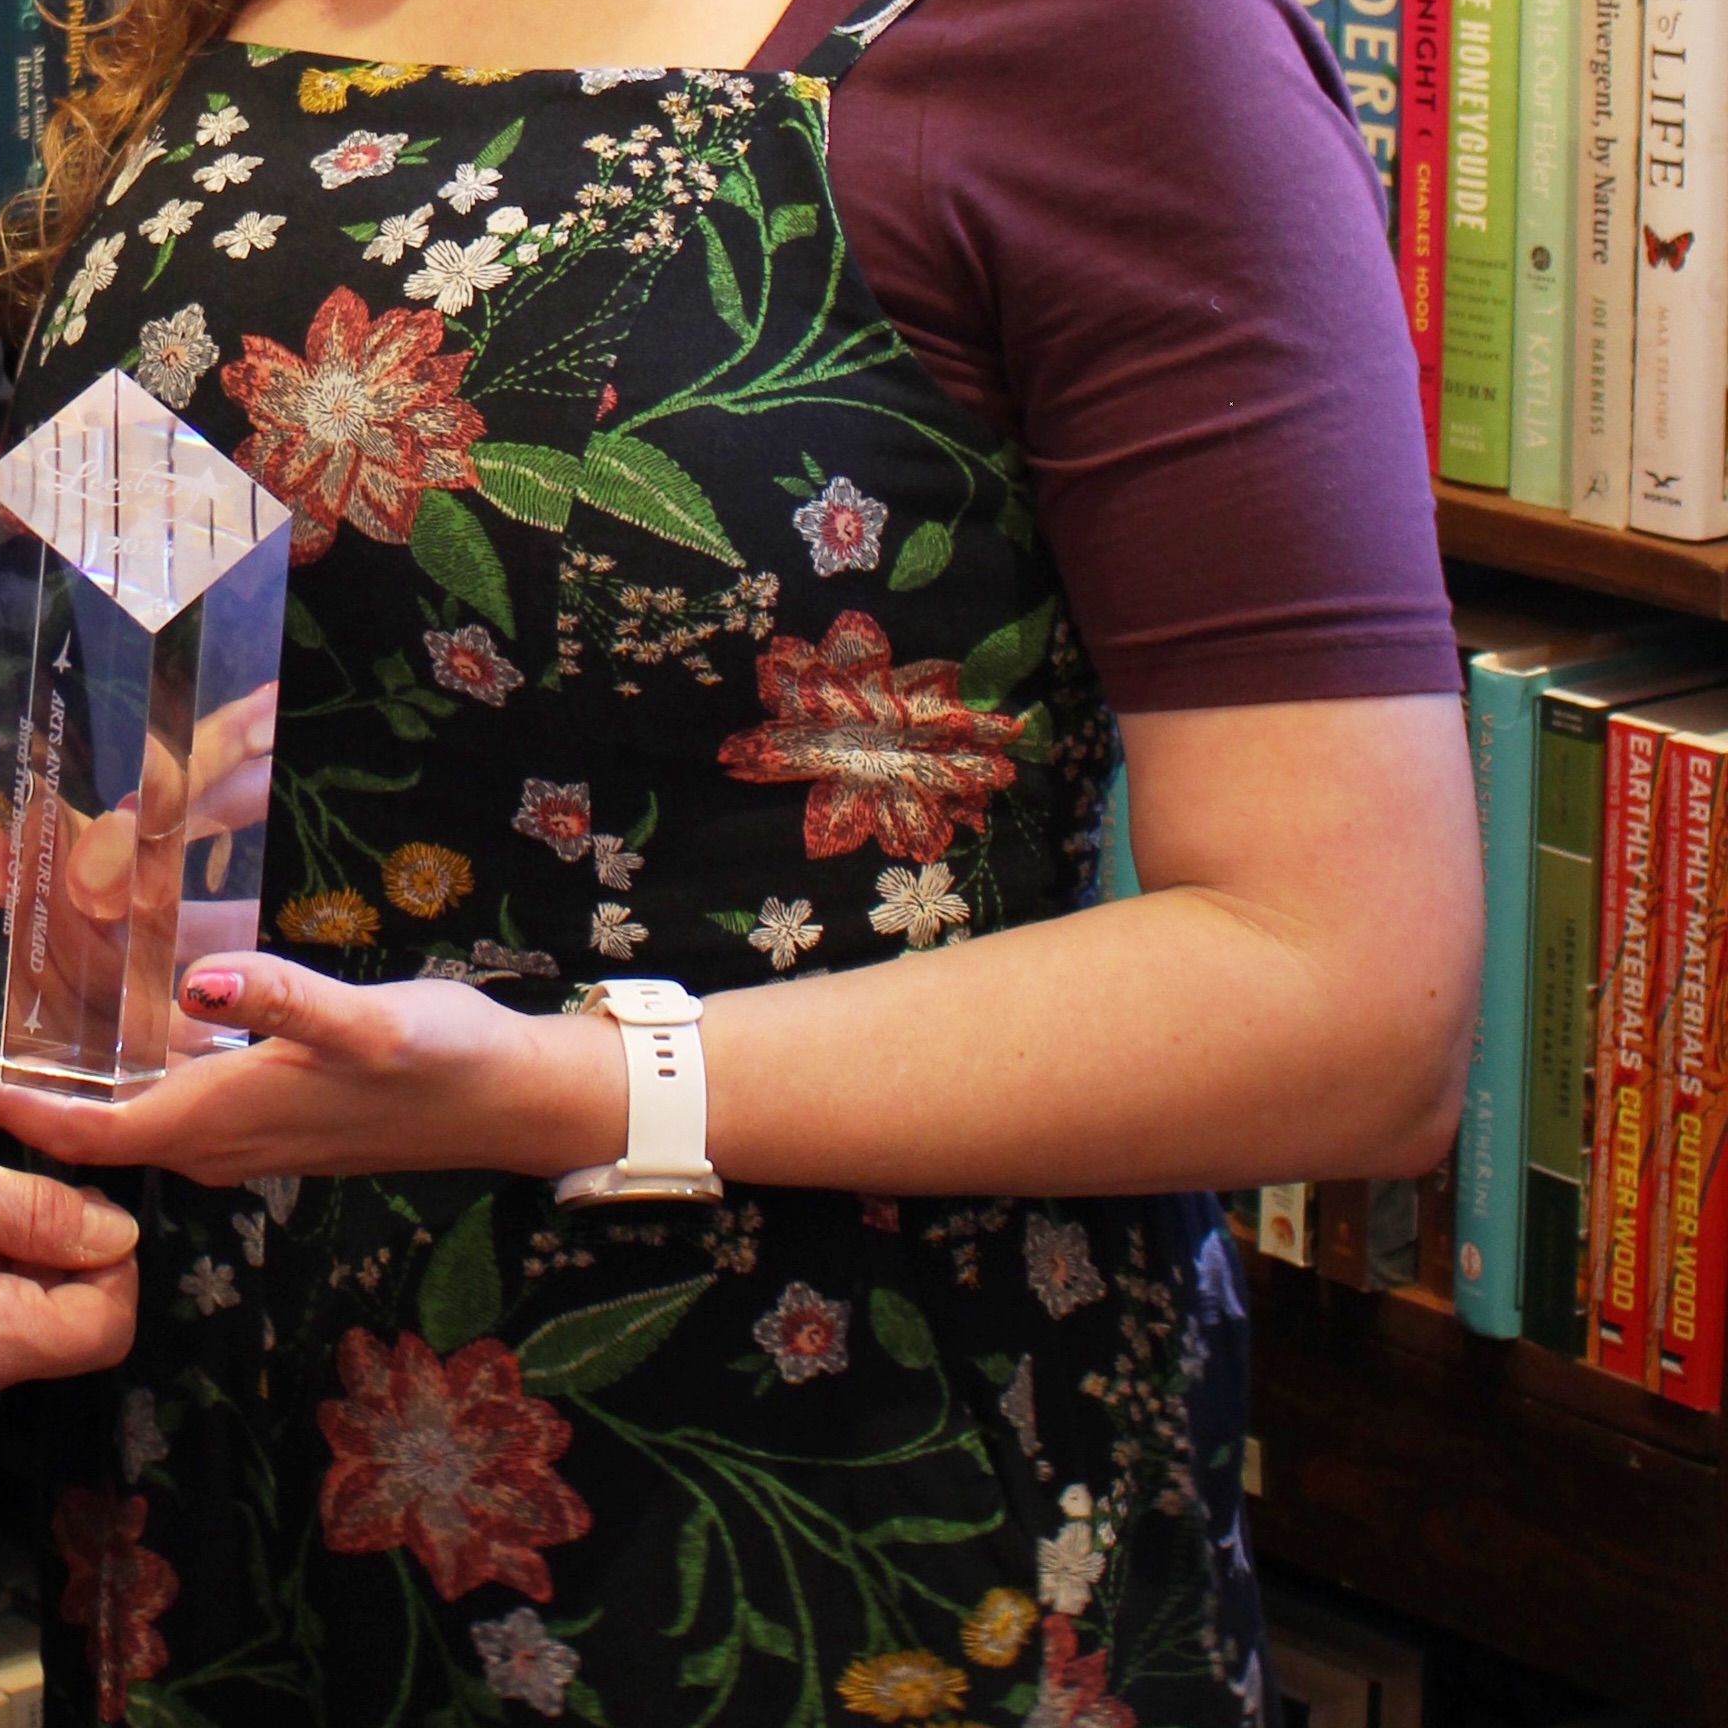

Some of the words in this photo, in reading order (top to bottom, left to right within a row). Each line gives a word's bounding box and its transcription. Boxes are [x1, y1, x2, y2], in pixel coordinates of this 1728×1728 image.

[1533, 56, 1560, 114] Our
[1534, 25, 1557, 49] Is
[1455, 21, 1492, 232] HONEYGUIDE
[1648, 44, 1687, 189] LIFE
[1590, 171, 1616, 265] Nature
[48, 688, 66, 744] ARTS
[45, 746, 61, 793] AND
[1626, 733, 1652, 883] EARTHLY
[35, 798, 57, 895] CULTURE
[1684, 755, 1711, 911] EARTHLY
[29, 898, 48, 974] AWARD
[1619, 878, 1648, 1071] MATERIALS
[1681, 904, 1707, 1097] MATERIALS
[1615, 1086, 1640, 1208] CUTTER
[1674, 1112, 1701, 1237] CUTTER
[1612, 1217, 1637, 1311] WOOD
[1674, 1244, 1696, 1341] WOOD
